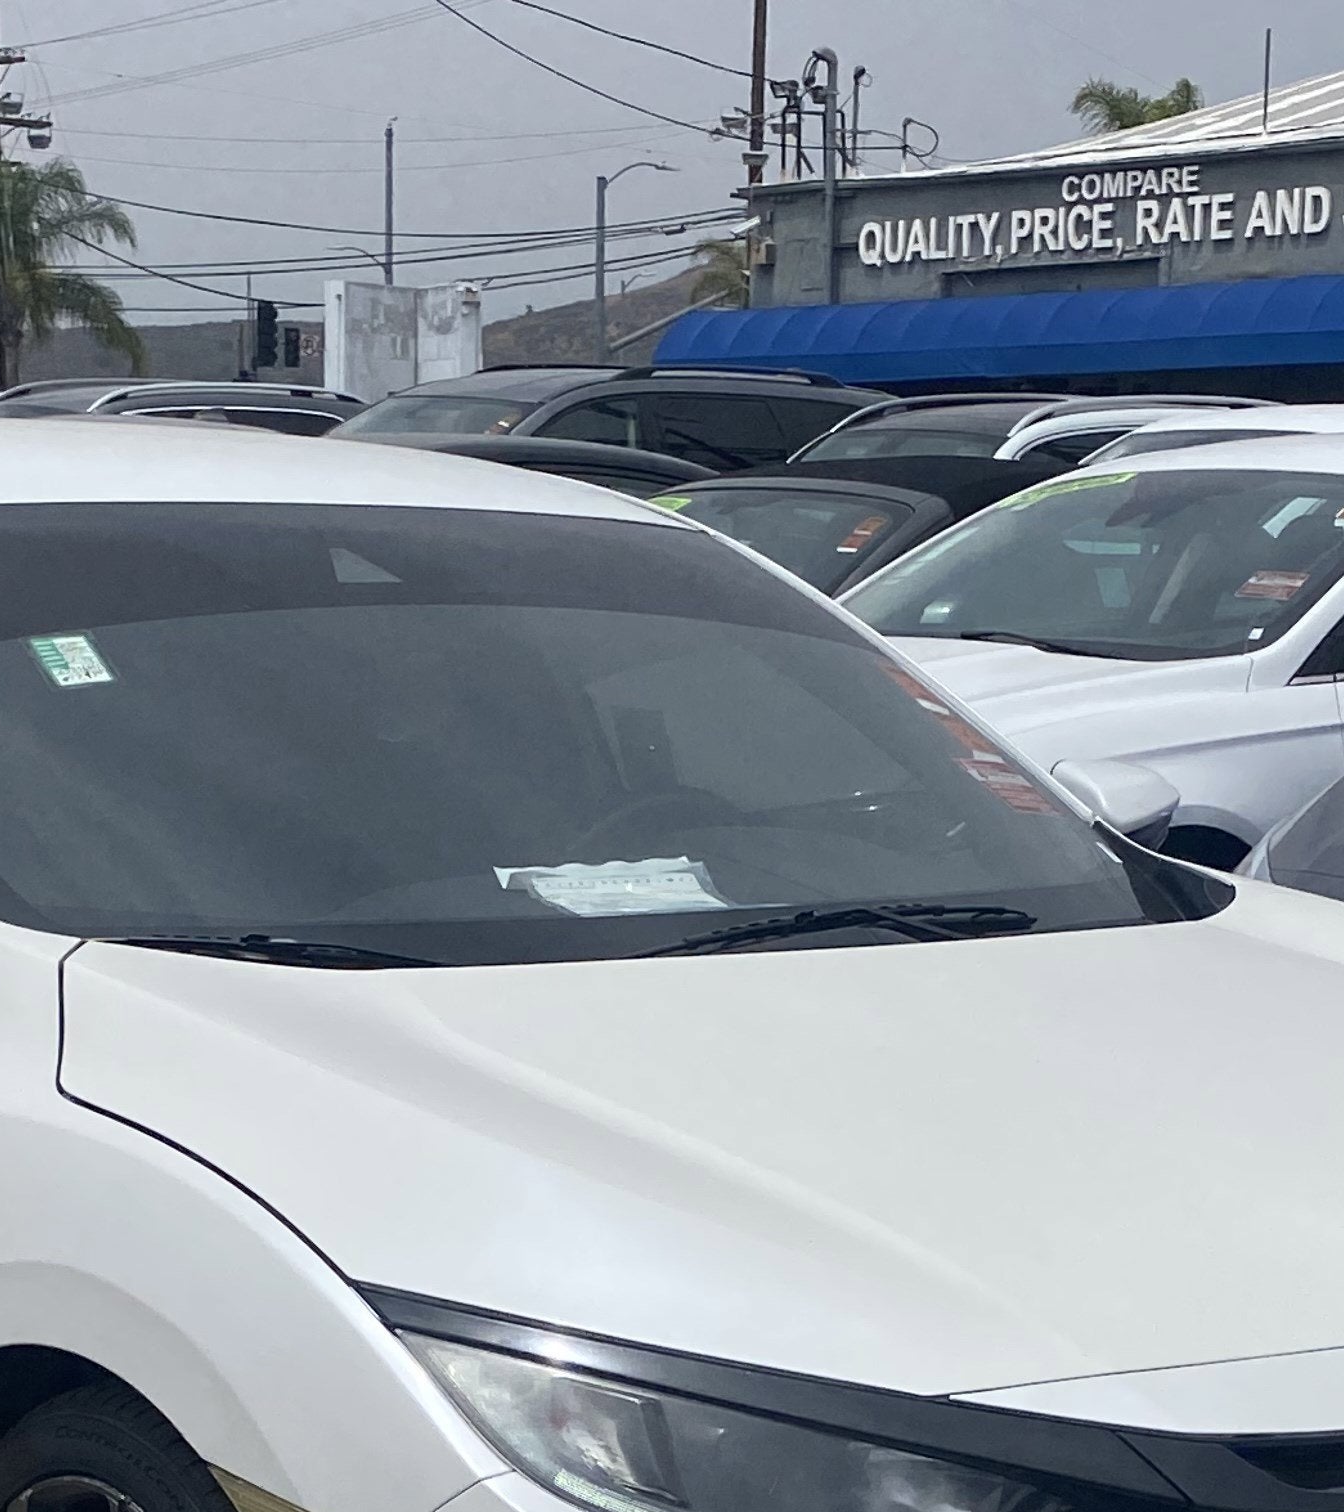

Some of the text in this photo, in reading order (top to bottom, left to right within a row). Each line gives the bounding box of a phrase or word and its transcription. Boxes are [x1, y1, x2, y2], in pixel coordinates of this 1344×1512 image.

[1061, 165, 1200, 201] COMPARE
[858, 211, 1005, 267] QUALITY,
[1010, 202, 1123, 256] PRICE,
[1135, 192, 1235, 246] RATE
[1244, 185, 1332, 239] AND
